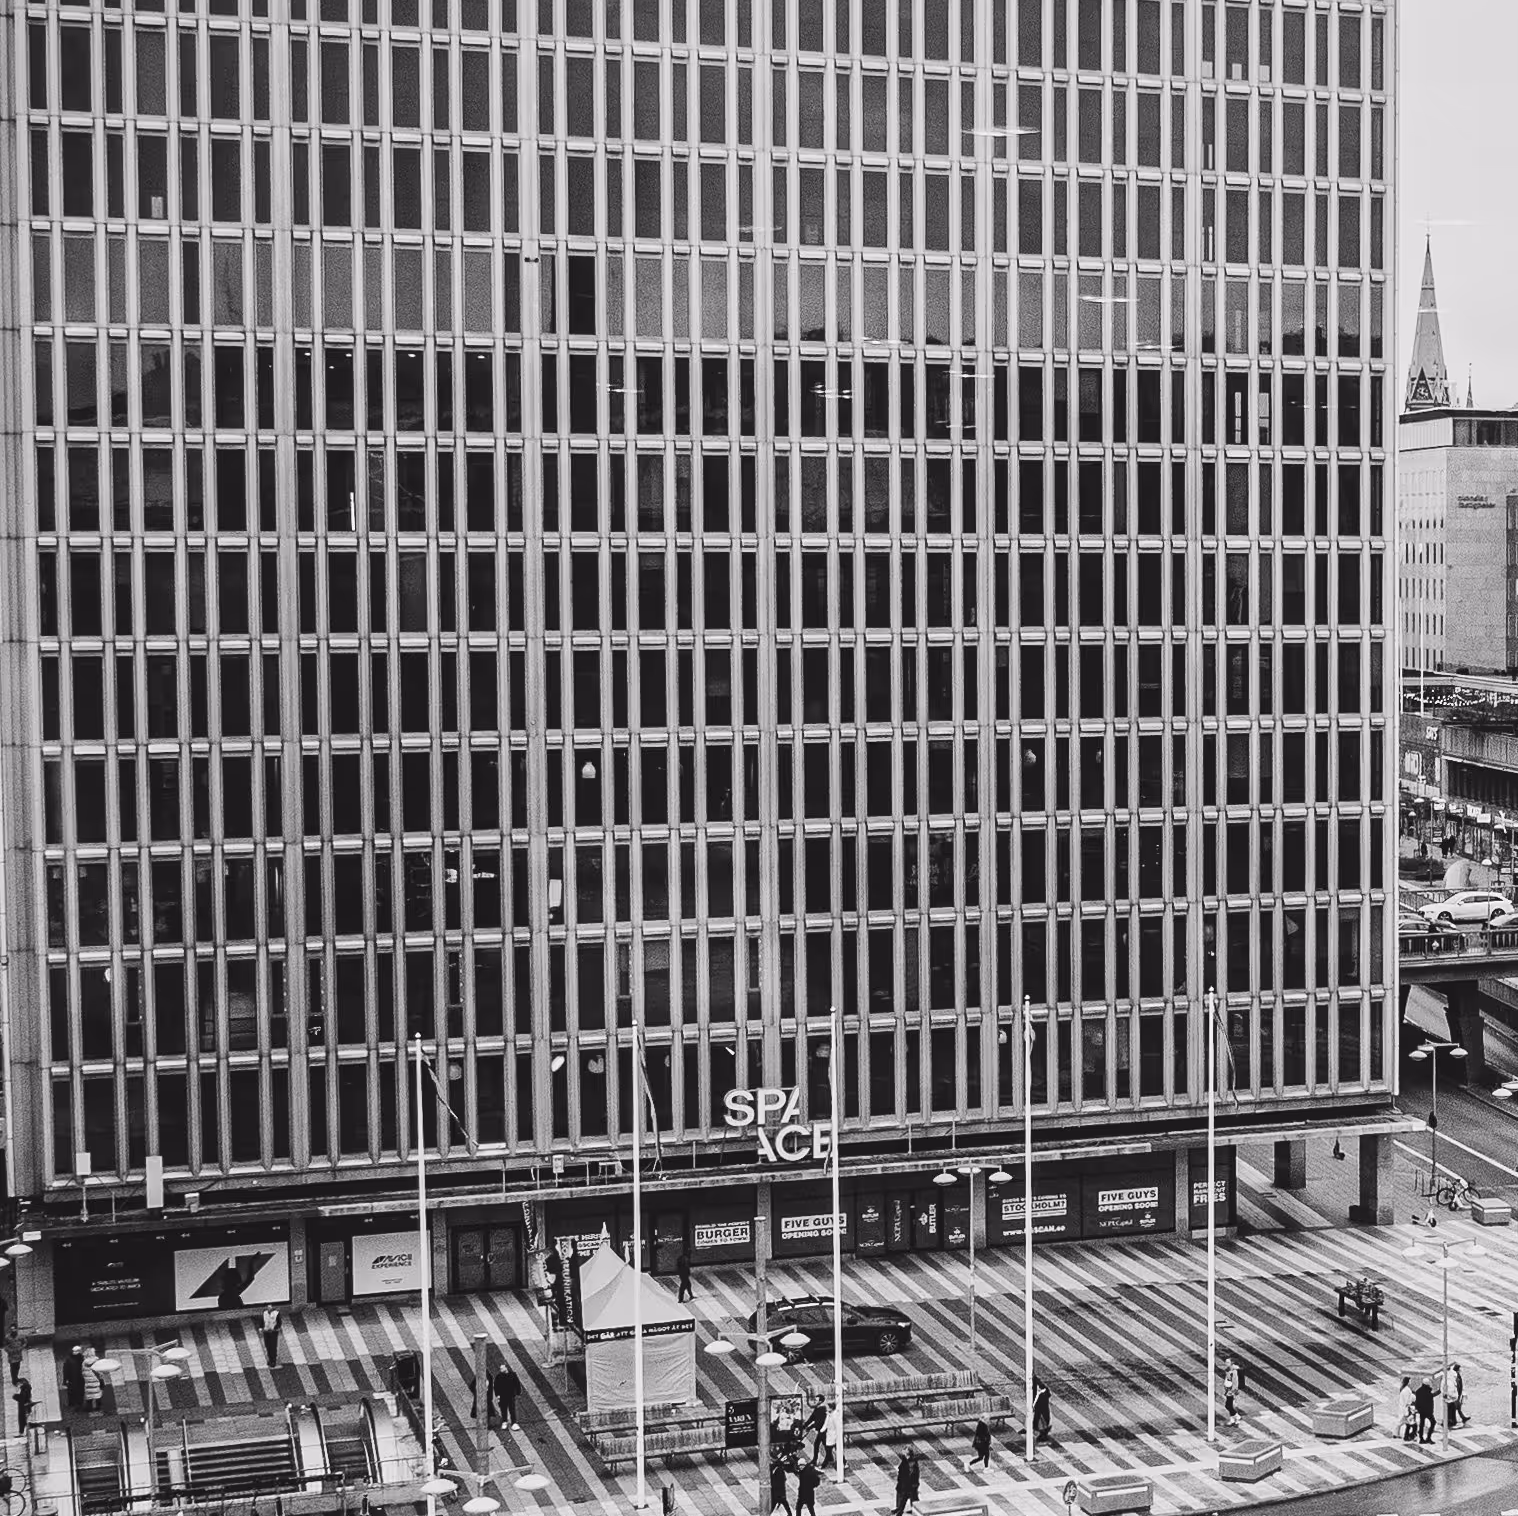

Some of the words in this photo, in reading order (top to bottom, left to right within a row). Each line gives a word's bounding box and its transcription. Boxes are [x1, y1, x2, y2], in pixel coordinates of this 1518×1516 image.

[1101, 1192, 1125, 1202] FIVE
[1127, 1189, 1157, 1199] GUYS
[1194, 1193, 1226, 1204] FRES
[1003, 1200, 1066, 1212] STOCHOLM?
[784, 1218, 810, 1229] FIVE
[696, 1227, 748, 1240] BURGER
[561, 1240, 574, 1324] KOMMUNIKATION
